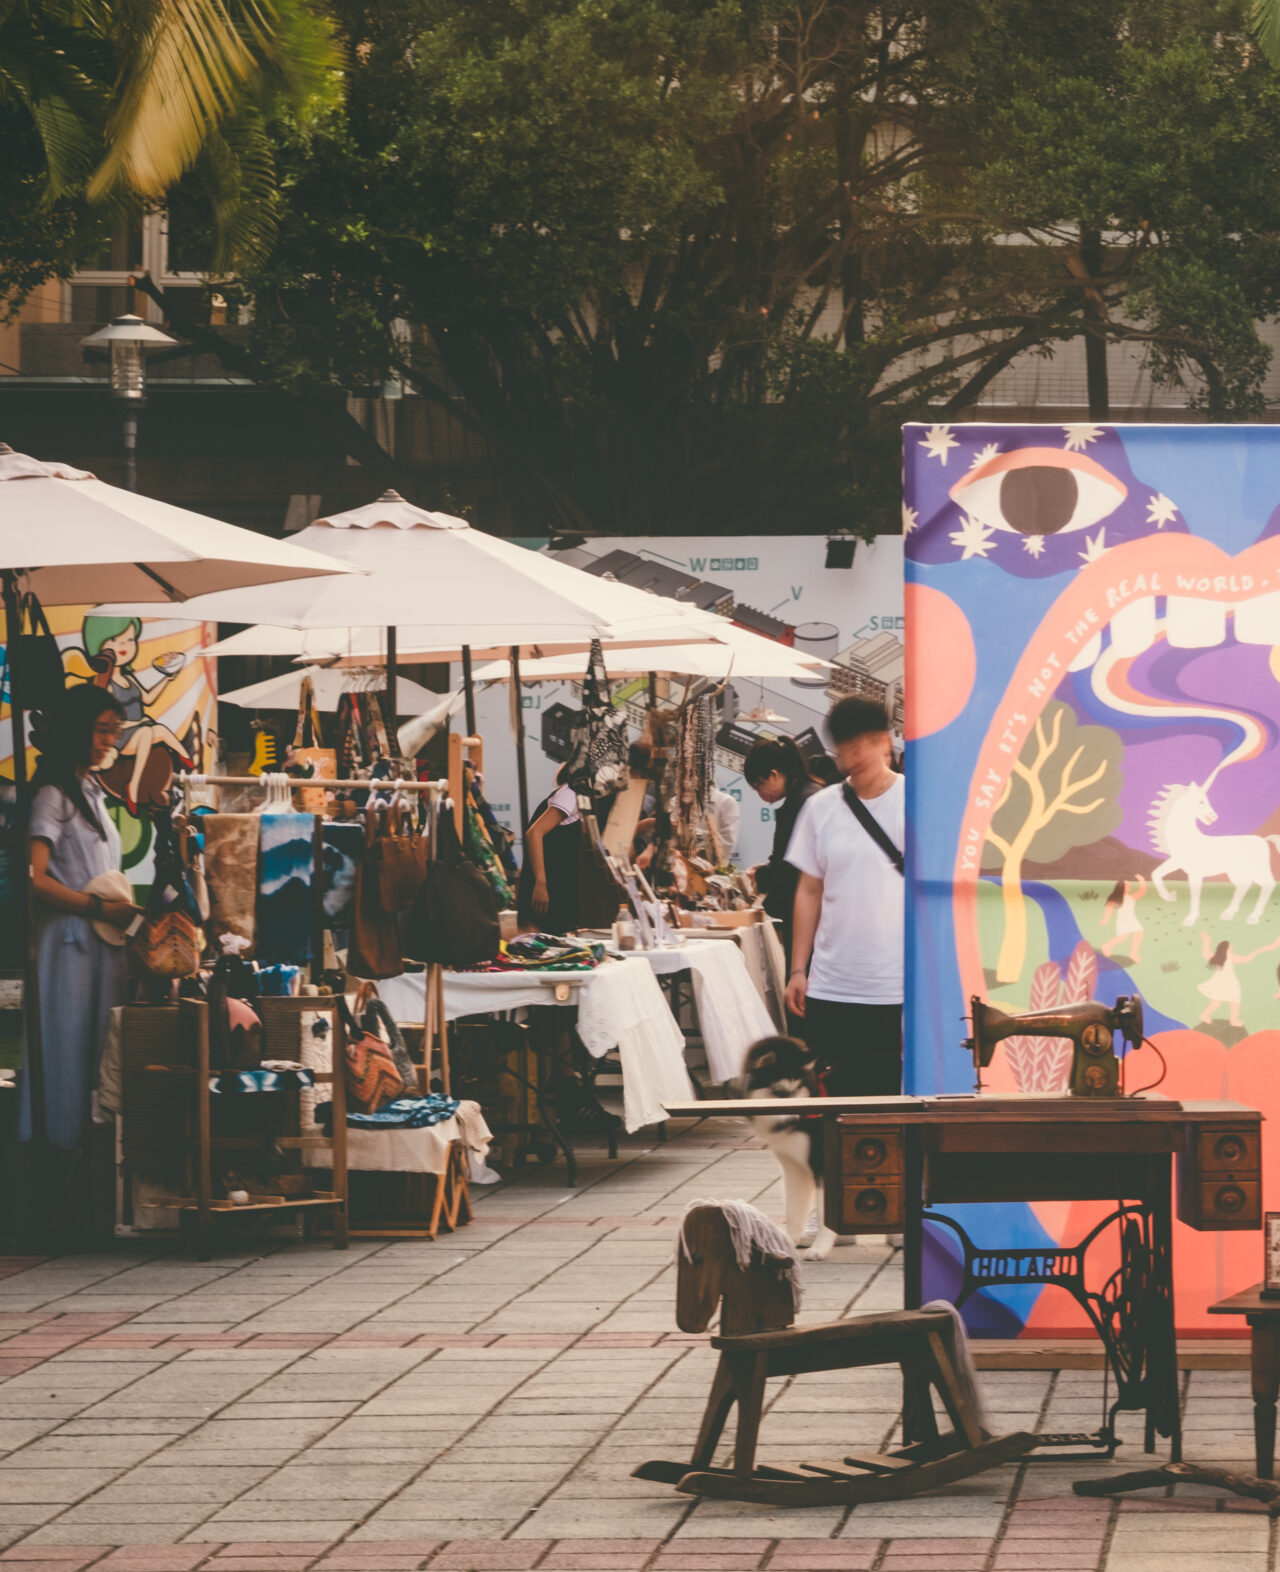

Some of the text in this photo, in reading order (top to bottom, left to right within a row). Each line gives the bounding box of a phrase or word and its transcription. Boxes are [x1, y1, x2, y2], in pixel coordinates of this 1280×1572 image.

[961, 828, 980, 869] YOU
[975, 767, 1002, 809] SAY
[999, 712, 1027, 753] IT'S
[1027, 651, 1061, 698] NOT
[1063, 607, 1100, 644] THE
[1105, 573, 1162, 608] REAL
[978, 1255, 1072, 1277] HOTARU
